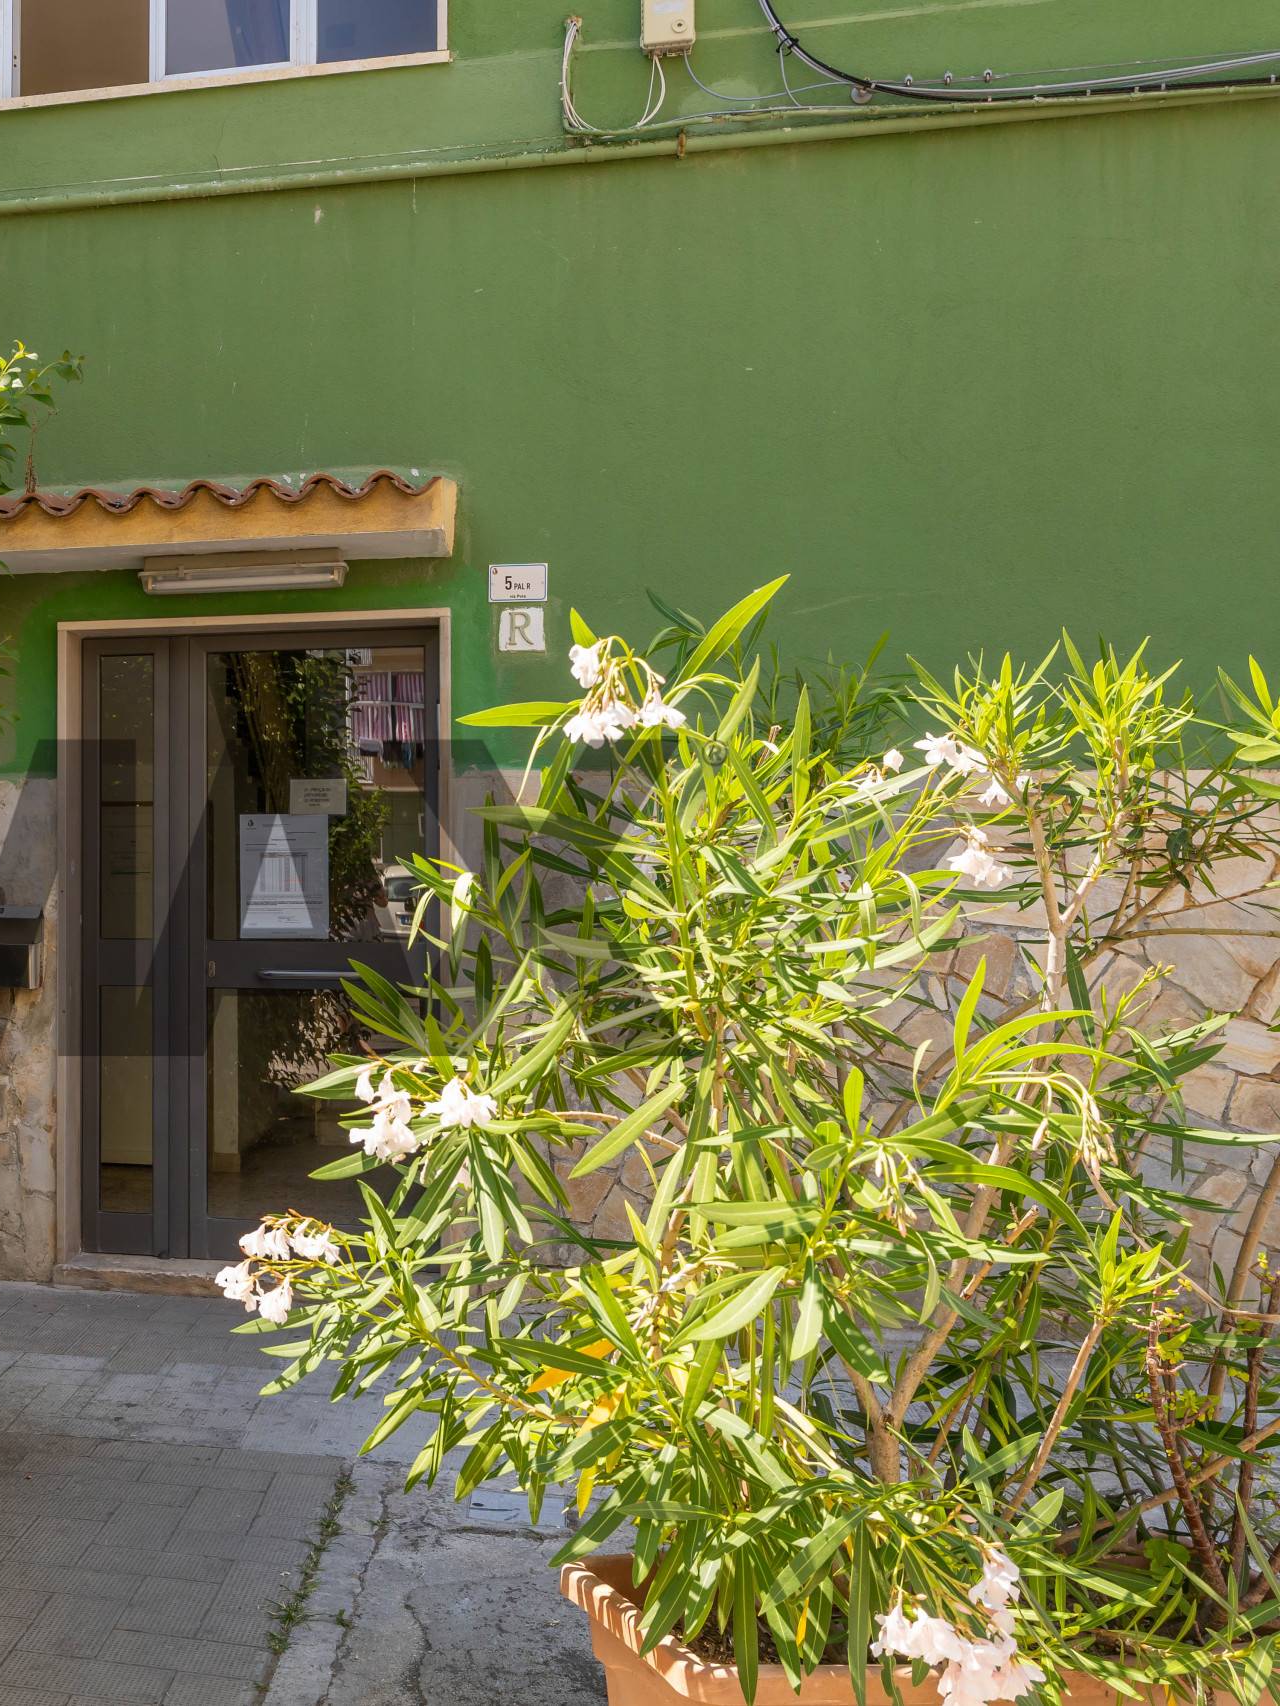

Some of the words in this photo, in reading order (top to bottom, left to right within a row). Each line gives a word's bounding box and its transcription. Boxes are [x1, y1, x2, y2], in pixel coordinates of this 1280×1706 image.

[505, 576, 512, 590] 5
[526, 582, 531, 590] R
[508, 612, 534, 646] R
